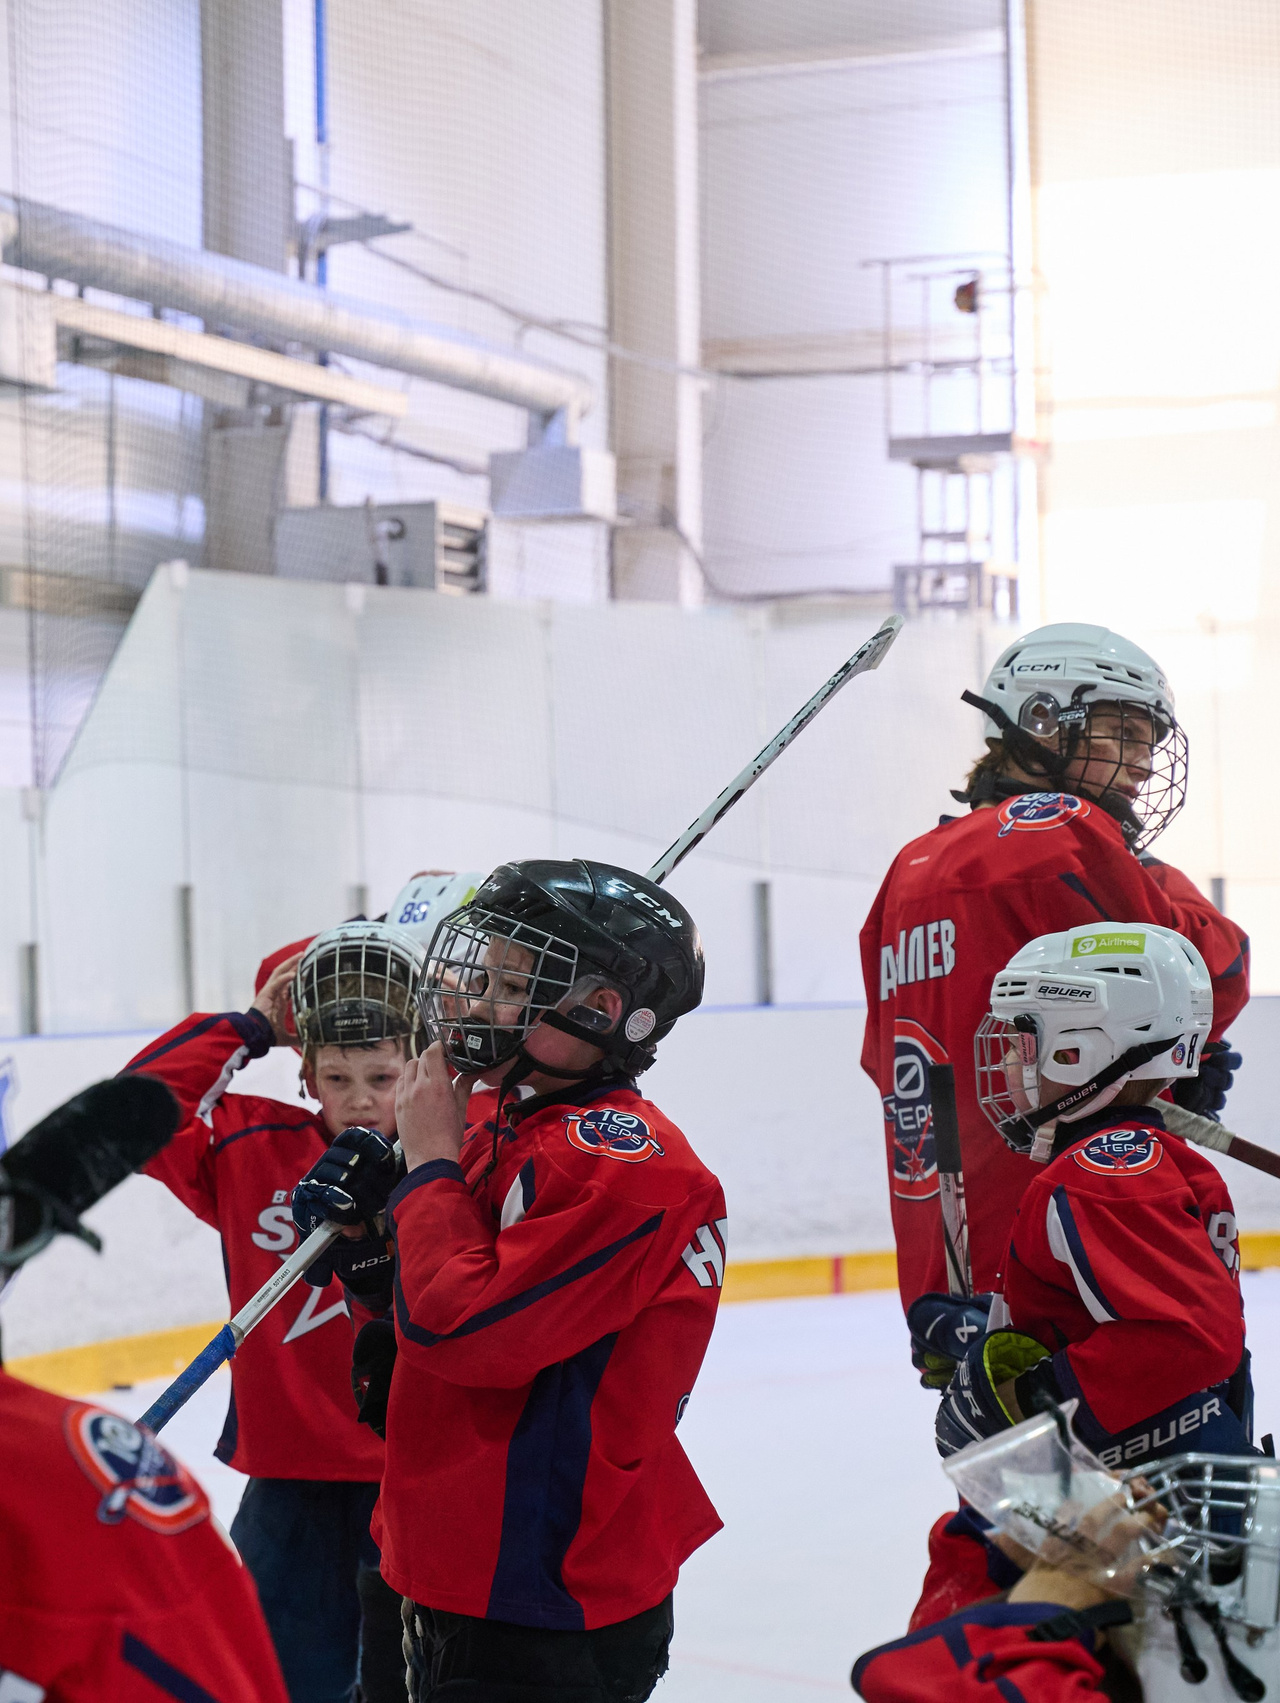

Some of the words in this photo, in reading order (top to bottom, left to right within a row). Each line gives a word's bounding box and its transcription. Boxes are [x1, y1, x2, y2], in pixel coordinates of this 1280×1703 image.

[1017, 663, 1061, 673] CCM
[484, 882, 501, 892] CM
[606, 877, 683, 928] CCM
[1099, 937, 1140, 948] Airlines
[1037, 985, 1092, 999] BAUER
[1056, 1082, 1099, 1111] BAUER
[601, 1110, 639, 1129] 10
[582, 1121, 642, 1147] STEPS
[1099, 1130, 1136, 1144] 10
[1088, 1143, 1148, 1155] STEPS
[351, 1255, 391, 1272] CCM
[1098, 1397, 1222, 1468] BAUER
